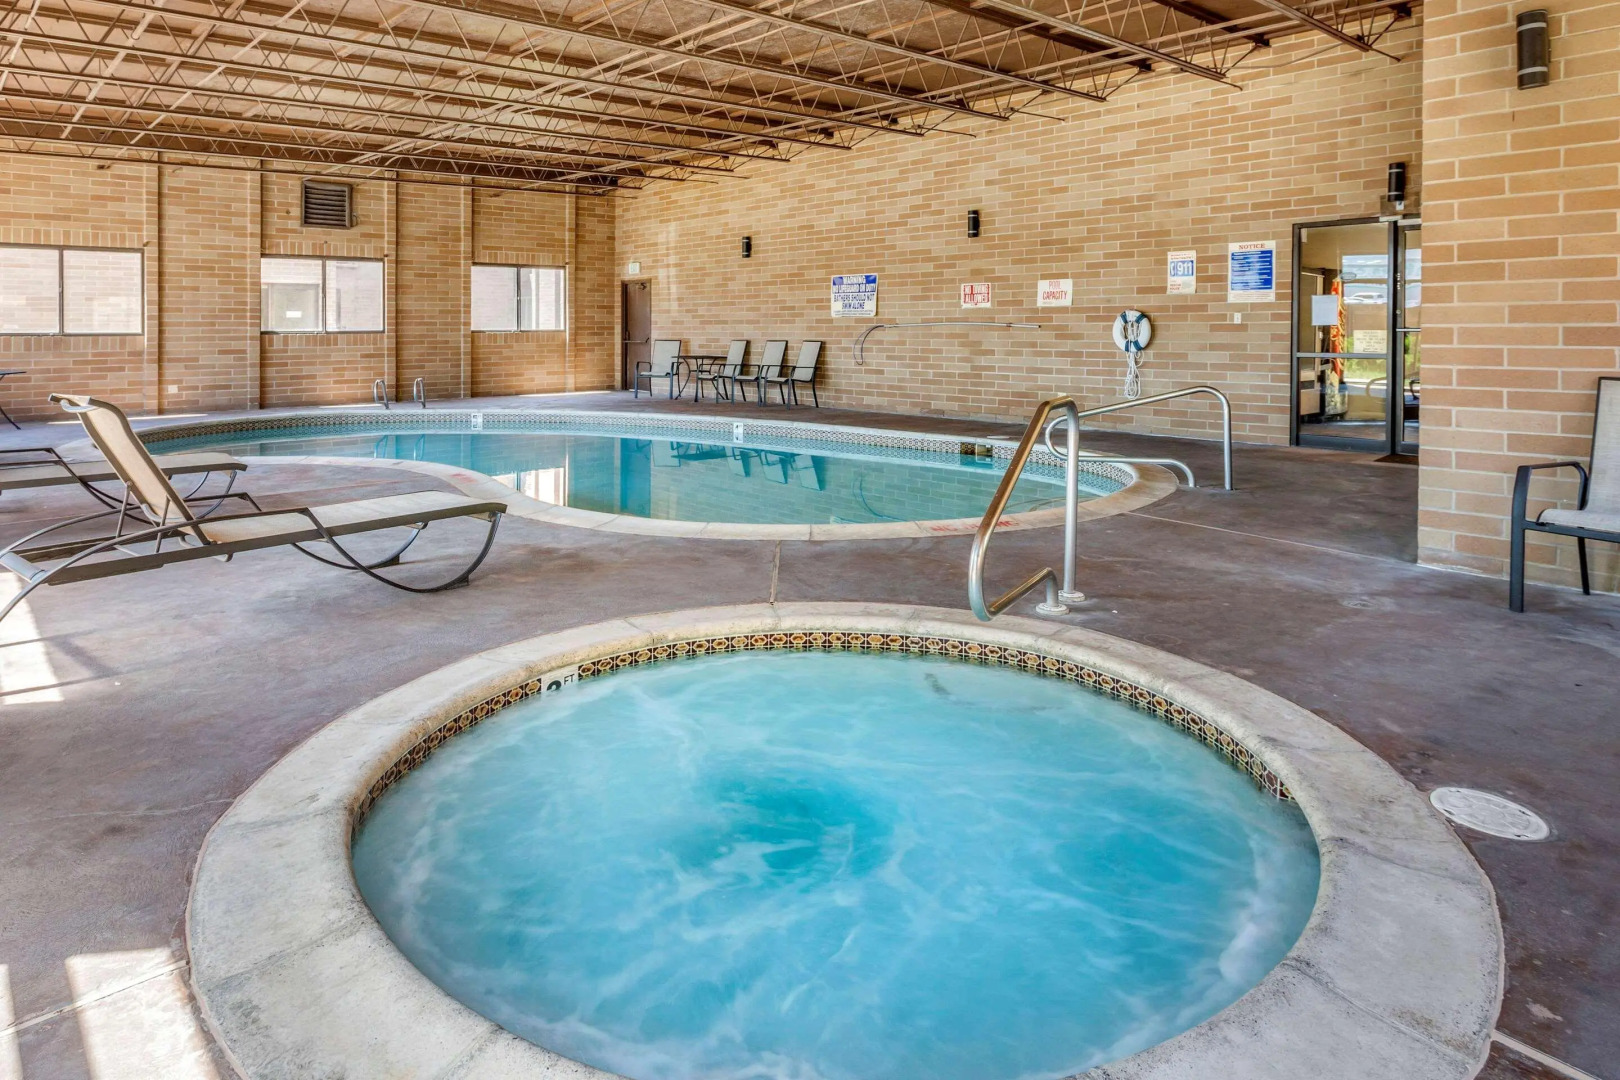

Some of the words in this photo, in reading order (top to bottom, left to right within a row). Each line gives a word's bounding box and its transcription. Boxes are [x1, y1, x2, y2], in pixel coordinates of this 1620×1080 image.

[1177, 261, 1193, 276] 911
[843, 275, 866, 284] WARNING
[839, 284, 860, 293] LIFEGUARD
[964, 285, 971, 294] NO
[1048, 280, 1062, 290] POOL
[867, 293, 875, 301] NOT
[965, 293, 989, 303] ALLOWED
[1042, 290, 1068, 300] CAPACITY
[563, 673, 575, 685] FT
